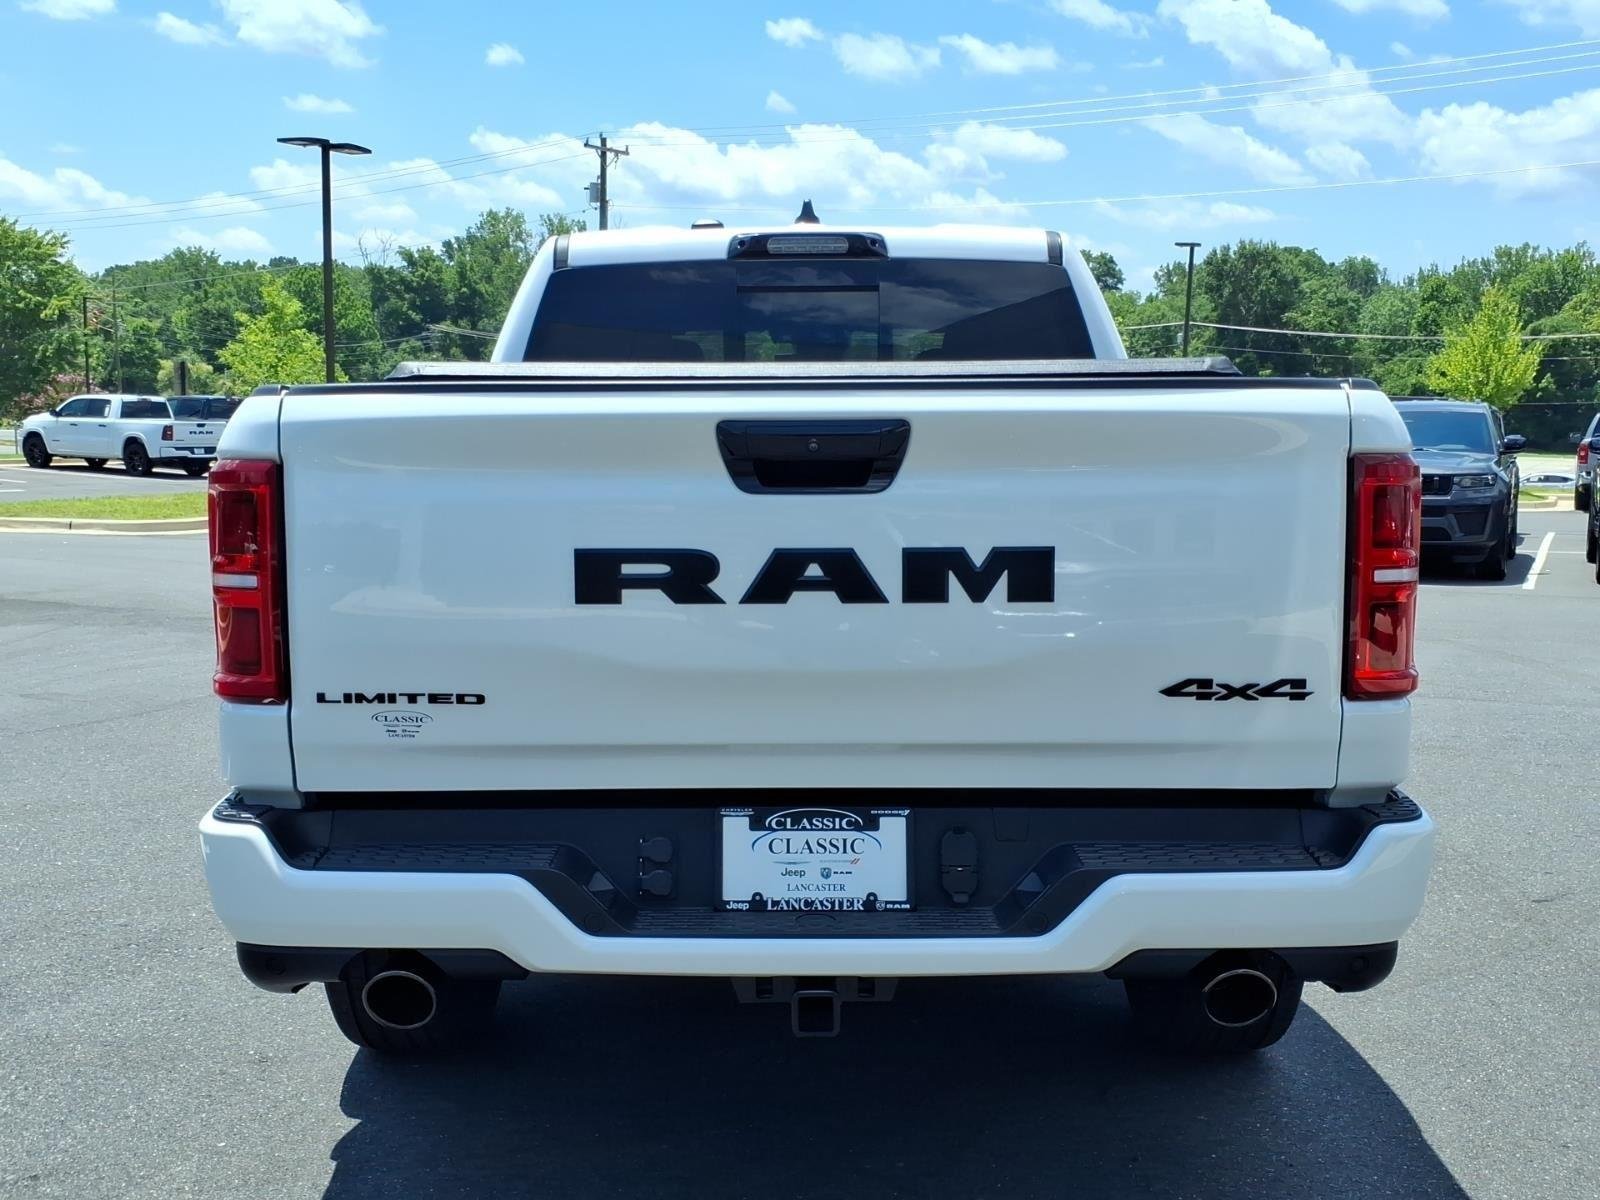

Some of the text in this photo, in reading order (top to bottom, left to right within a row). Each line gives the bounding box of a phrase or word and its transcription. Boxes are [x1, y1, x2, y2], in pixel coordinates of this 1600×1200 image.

[574, 546, 1055, 604] RAM
[1159, 678, 1314, 701] 4x4
[316, 692, 486, 705] LIMITED
[375, 714, 428, 723] CLASSIC
[771, 817, 855, 829] CLASSIC
[768, 837, 865, 854] CLASSIC
[781, 867, 806, 878] Jeep
[787, 883, 846, 892] LANCASTER
[726, 901, 749, 911] Jeep
[767, 897, 864, 911] LANCASTER
